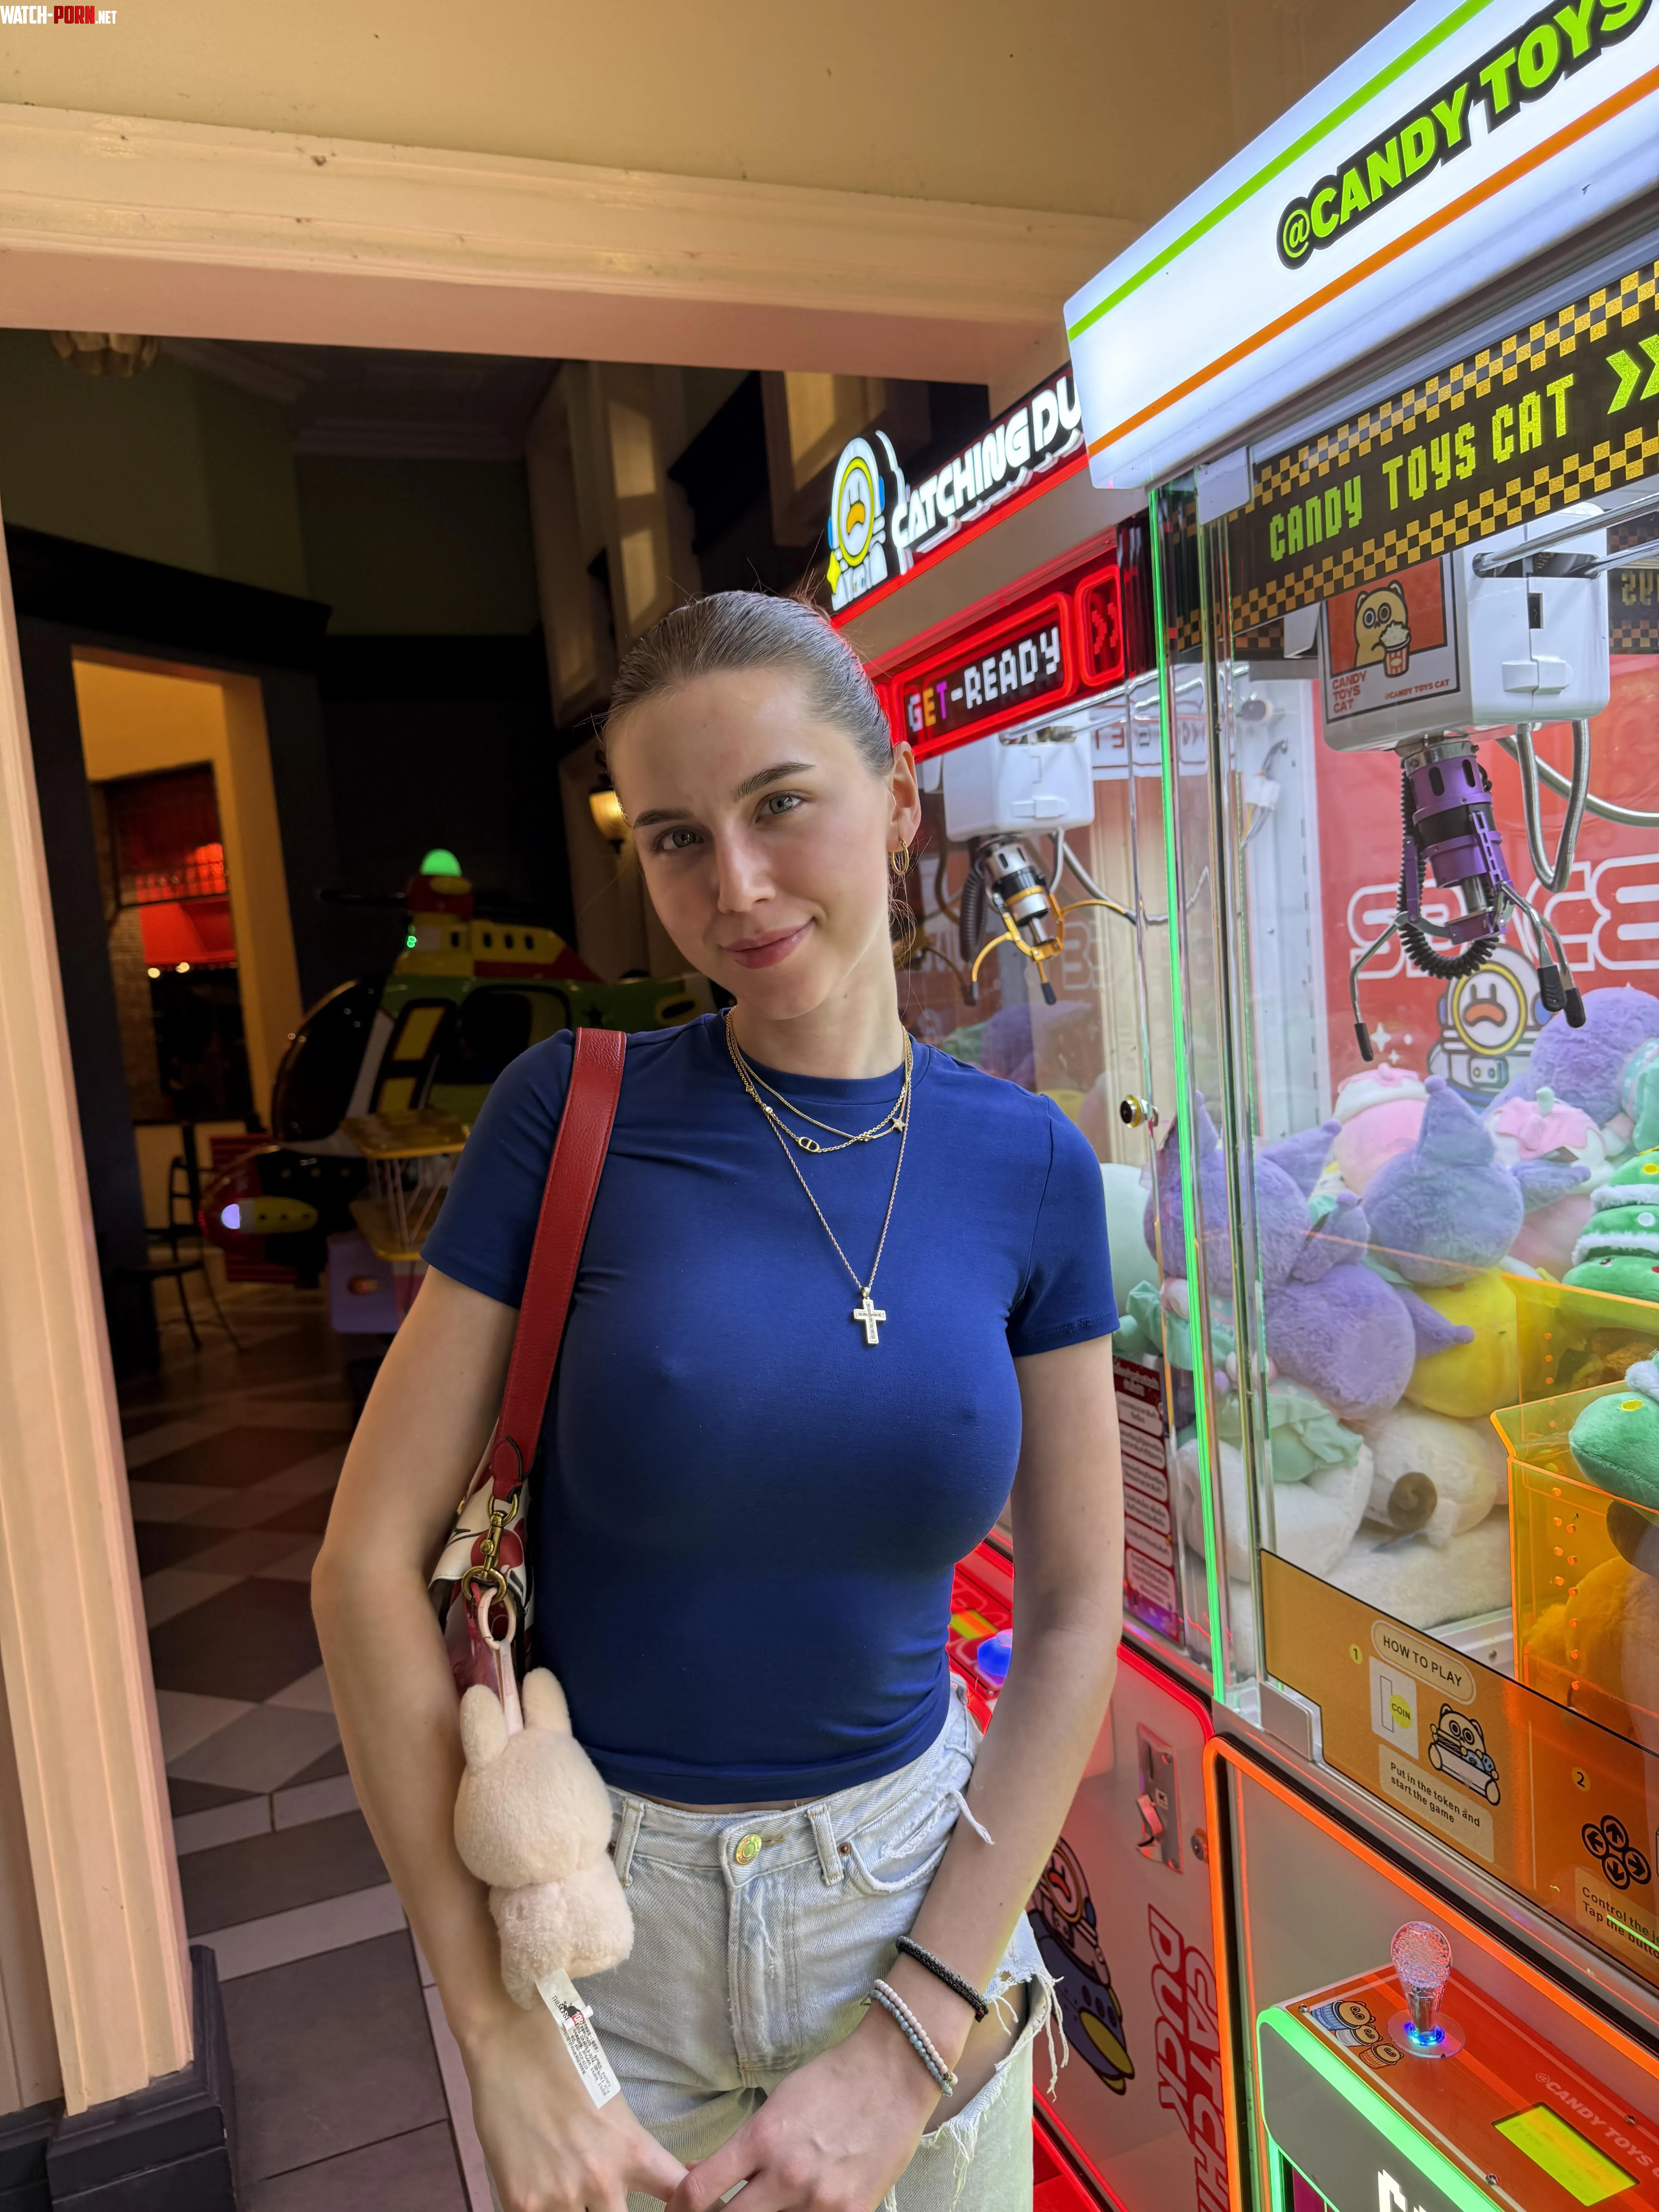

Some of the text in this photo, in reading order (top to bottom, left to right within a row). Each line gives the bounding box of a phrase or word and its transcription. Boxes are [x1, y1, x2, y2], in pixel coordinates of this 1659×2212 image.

[1283, 0, 1642, 258] @CANDY TOYS
[891, 407, 1030, 549] CATCHING
[1269, 373, 1573, 562] CANDY TOYS CAT
[907, 626, 1061, 732] GET-READY
[1332, 671, 1367, 690] CANDY
[1333, 685, 1361, 701] TOYS
[1414, 682, 1433, 693] TOYS
[1434, 679, 1450, 688] CAT
[1333, 698, 1354, 714] CAT
[1353, 1648, 1358, 1660] 1
[1383, 1635, 1462, 1687] HOW TO PLAY
[1391, 1703, 1410, 1720] COIN
[1391, 1762, 1480, 1827] Put in the token and
[1391, 1776, 1454, 1823] start the game
[1577, 1771, 1585, 1788] 2
[1582, 1887, 1626, 1923] Control
[1629, 1917, 1649, 1936] the
[1583, 1900, 1603, 1922] Tap
[1606, 1917, 1625, 1936] the
[1148, 1903, 1195, 2146] DUCK
[1184, 1946, 1231, 2212] CATCHI
[1536, 2073, 1654, 2166] @CANDY TOYS
